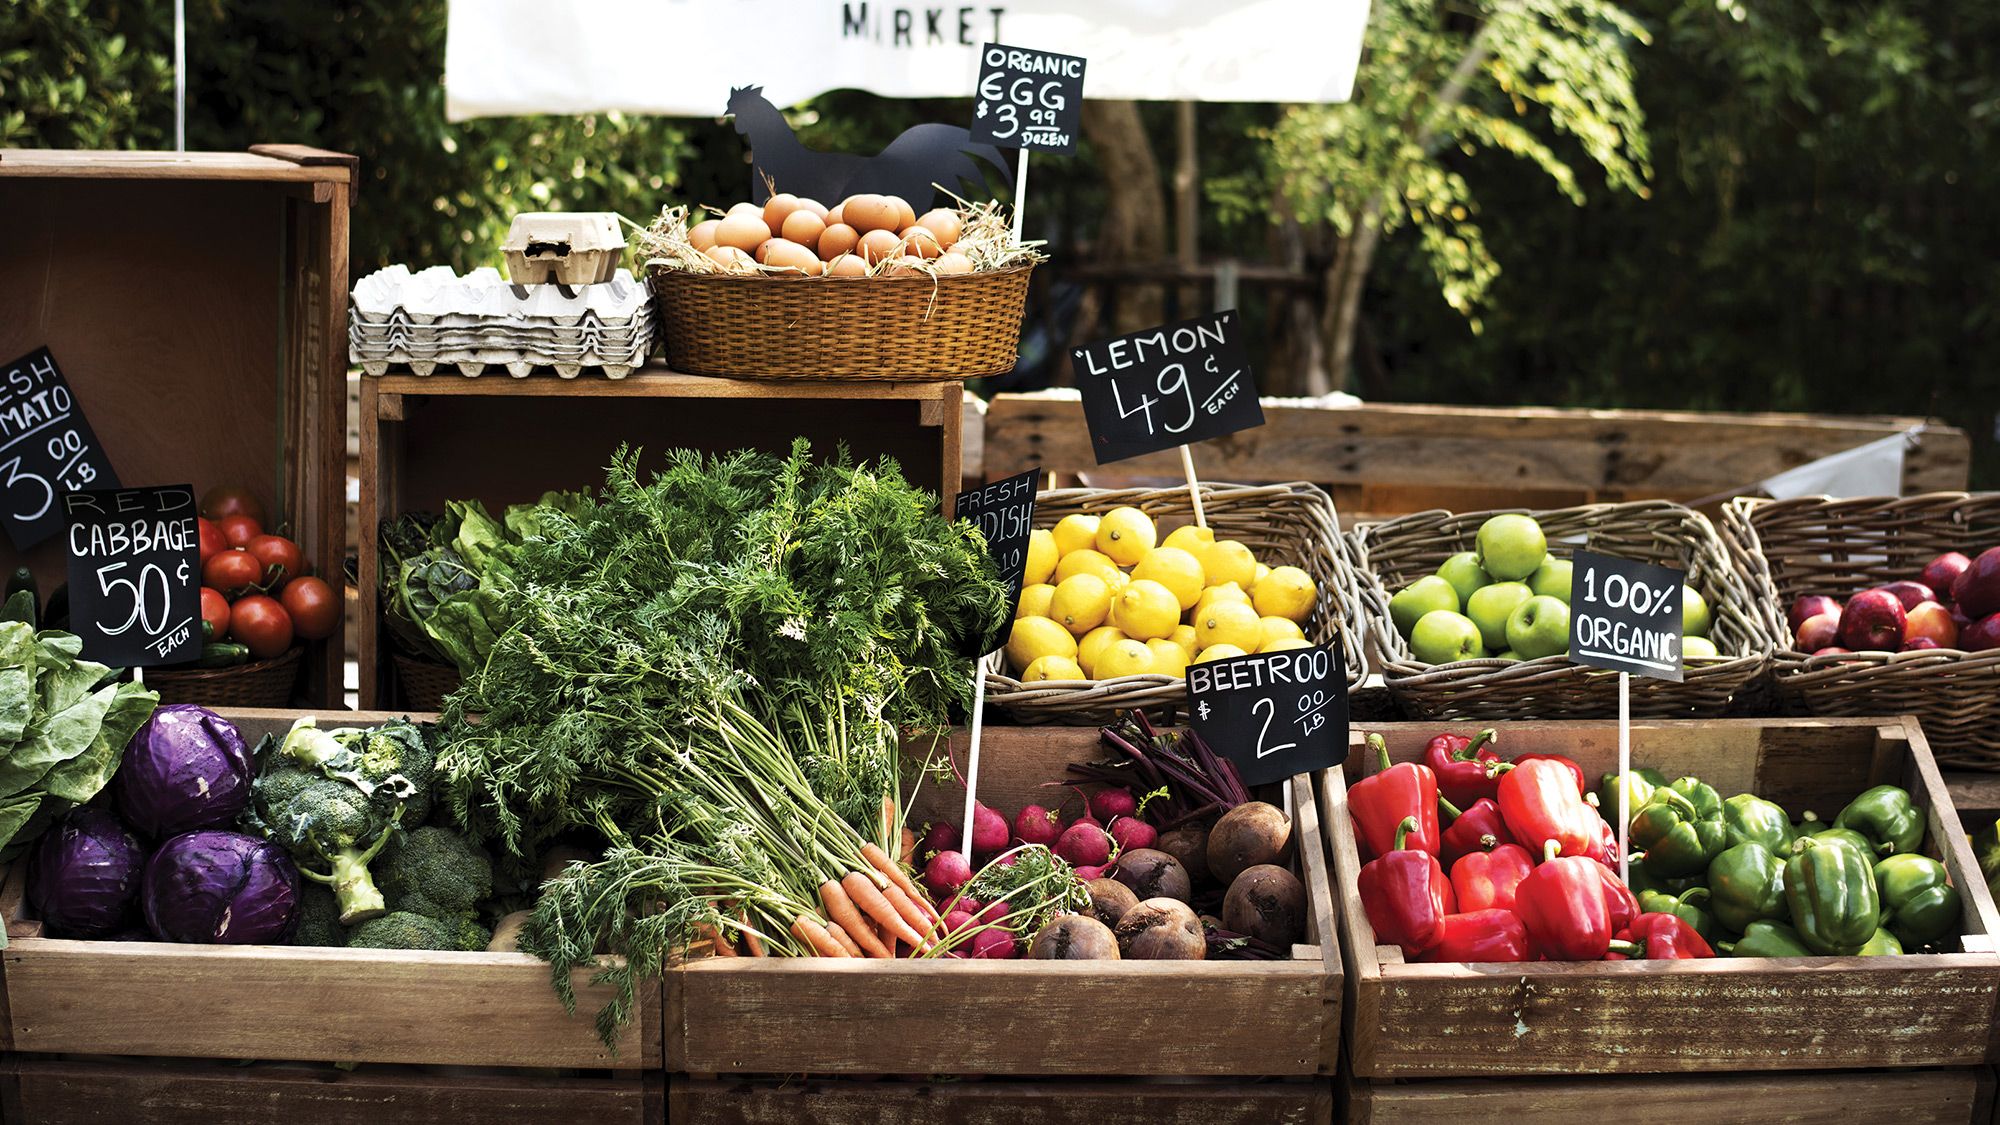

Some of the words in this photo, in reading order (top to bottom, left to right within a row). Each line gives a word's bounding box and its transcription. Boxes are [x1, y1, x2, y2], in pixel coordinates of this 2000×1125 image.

[843, 2, 1004, 47] MRKET
[986, 49, 1081, 78] ORGANIC
[980, 72, 1065, 111] EGG
[1021, 131, 1070, 147] DOZEN
[1207, 382, 1240, 415] EACH
[65, 462, 96, 491] LB
[65, 490, 191, 515] RED
[957, 476, 1030, 514] FRESH
[70, 518, 196, 557] CABBAGE
[1584, 567, 1675, 617] 100%
[157, 627, 190, 658] EACH
[1576, 613, 1678, 662] ORGANIC
[1190, 641, 1336, 694] BEETROOT
[1303, 713, 1325, 736] LB
